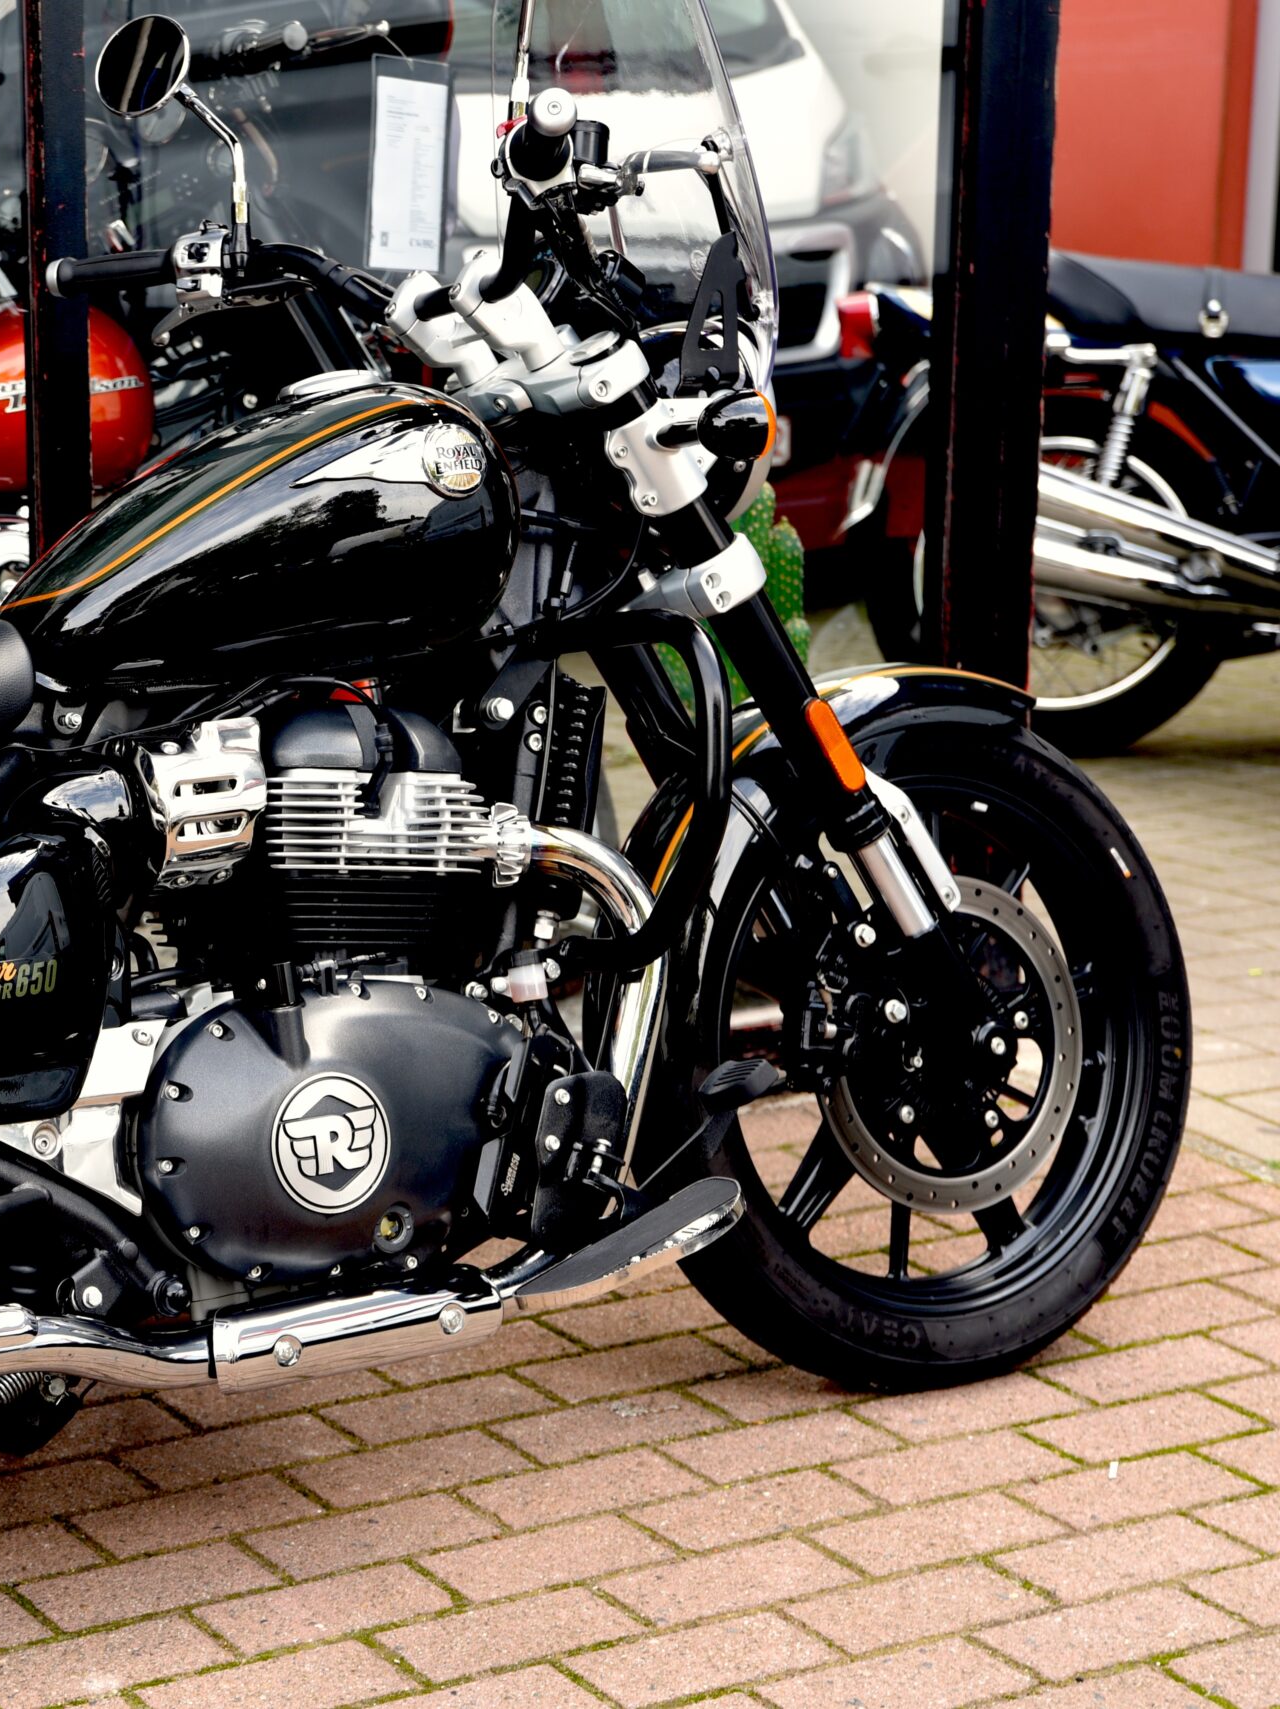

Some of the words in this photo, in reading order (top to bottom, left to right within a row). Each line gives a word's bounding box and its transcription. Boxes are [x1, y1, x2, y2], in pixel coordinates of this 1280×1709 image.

[435, 445, 477, 460] ROYAL
[434, 459, 483, 475] ENFIELD
[15, 959, 58, 998] 650
